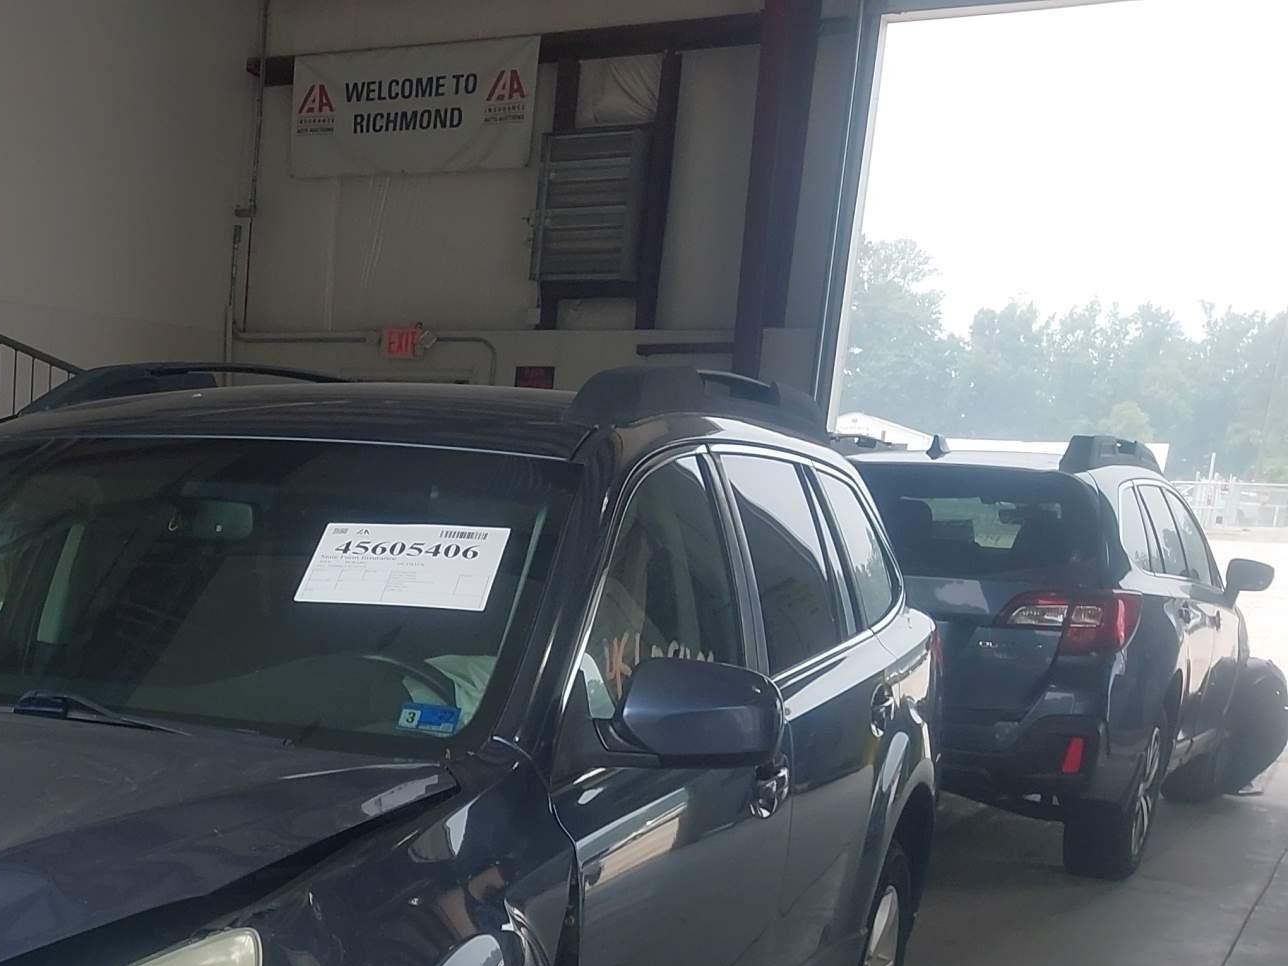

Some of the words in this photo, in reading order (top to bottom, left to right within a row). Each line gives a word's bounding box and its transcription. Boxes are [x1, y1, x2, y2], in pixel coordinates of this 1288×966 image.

[345, 76, 445, 103] WELCOME
[453, 73, 478, 95] TO
[353, 107, 463, 134] RICHMOND
[387, 331, 417, 353] EXIT
[334, 540, 480, 561] 45605406
[406, 711, 416, 724] 3
